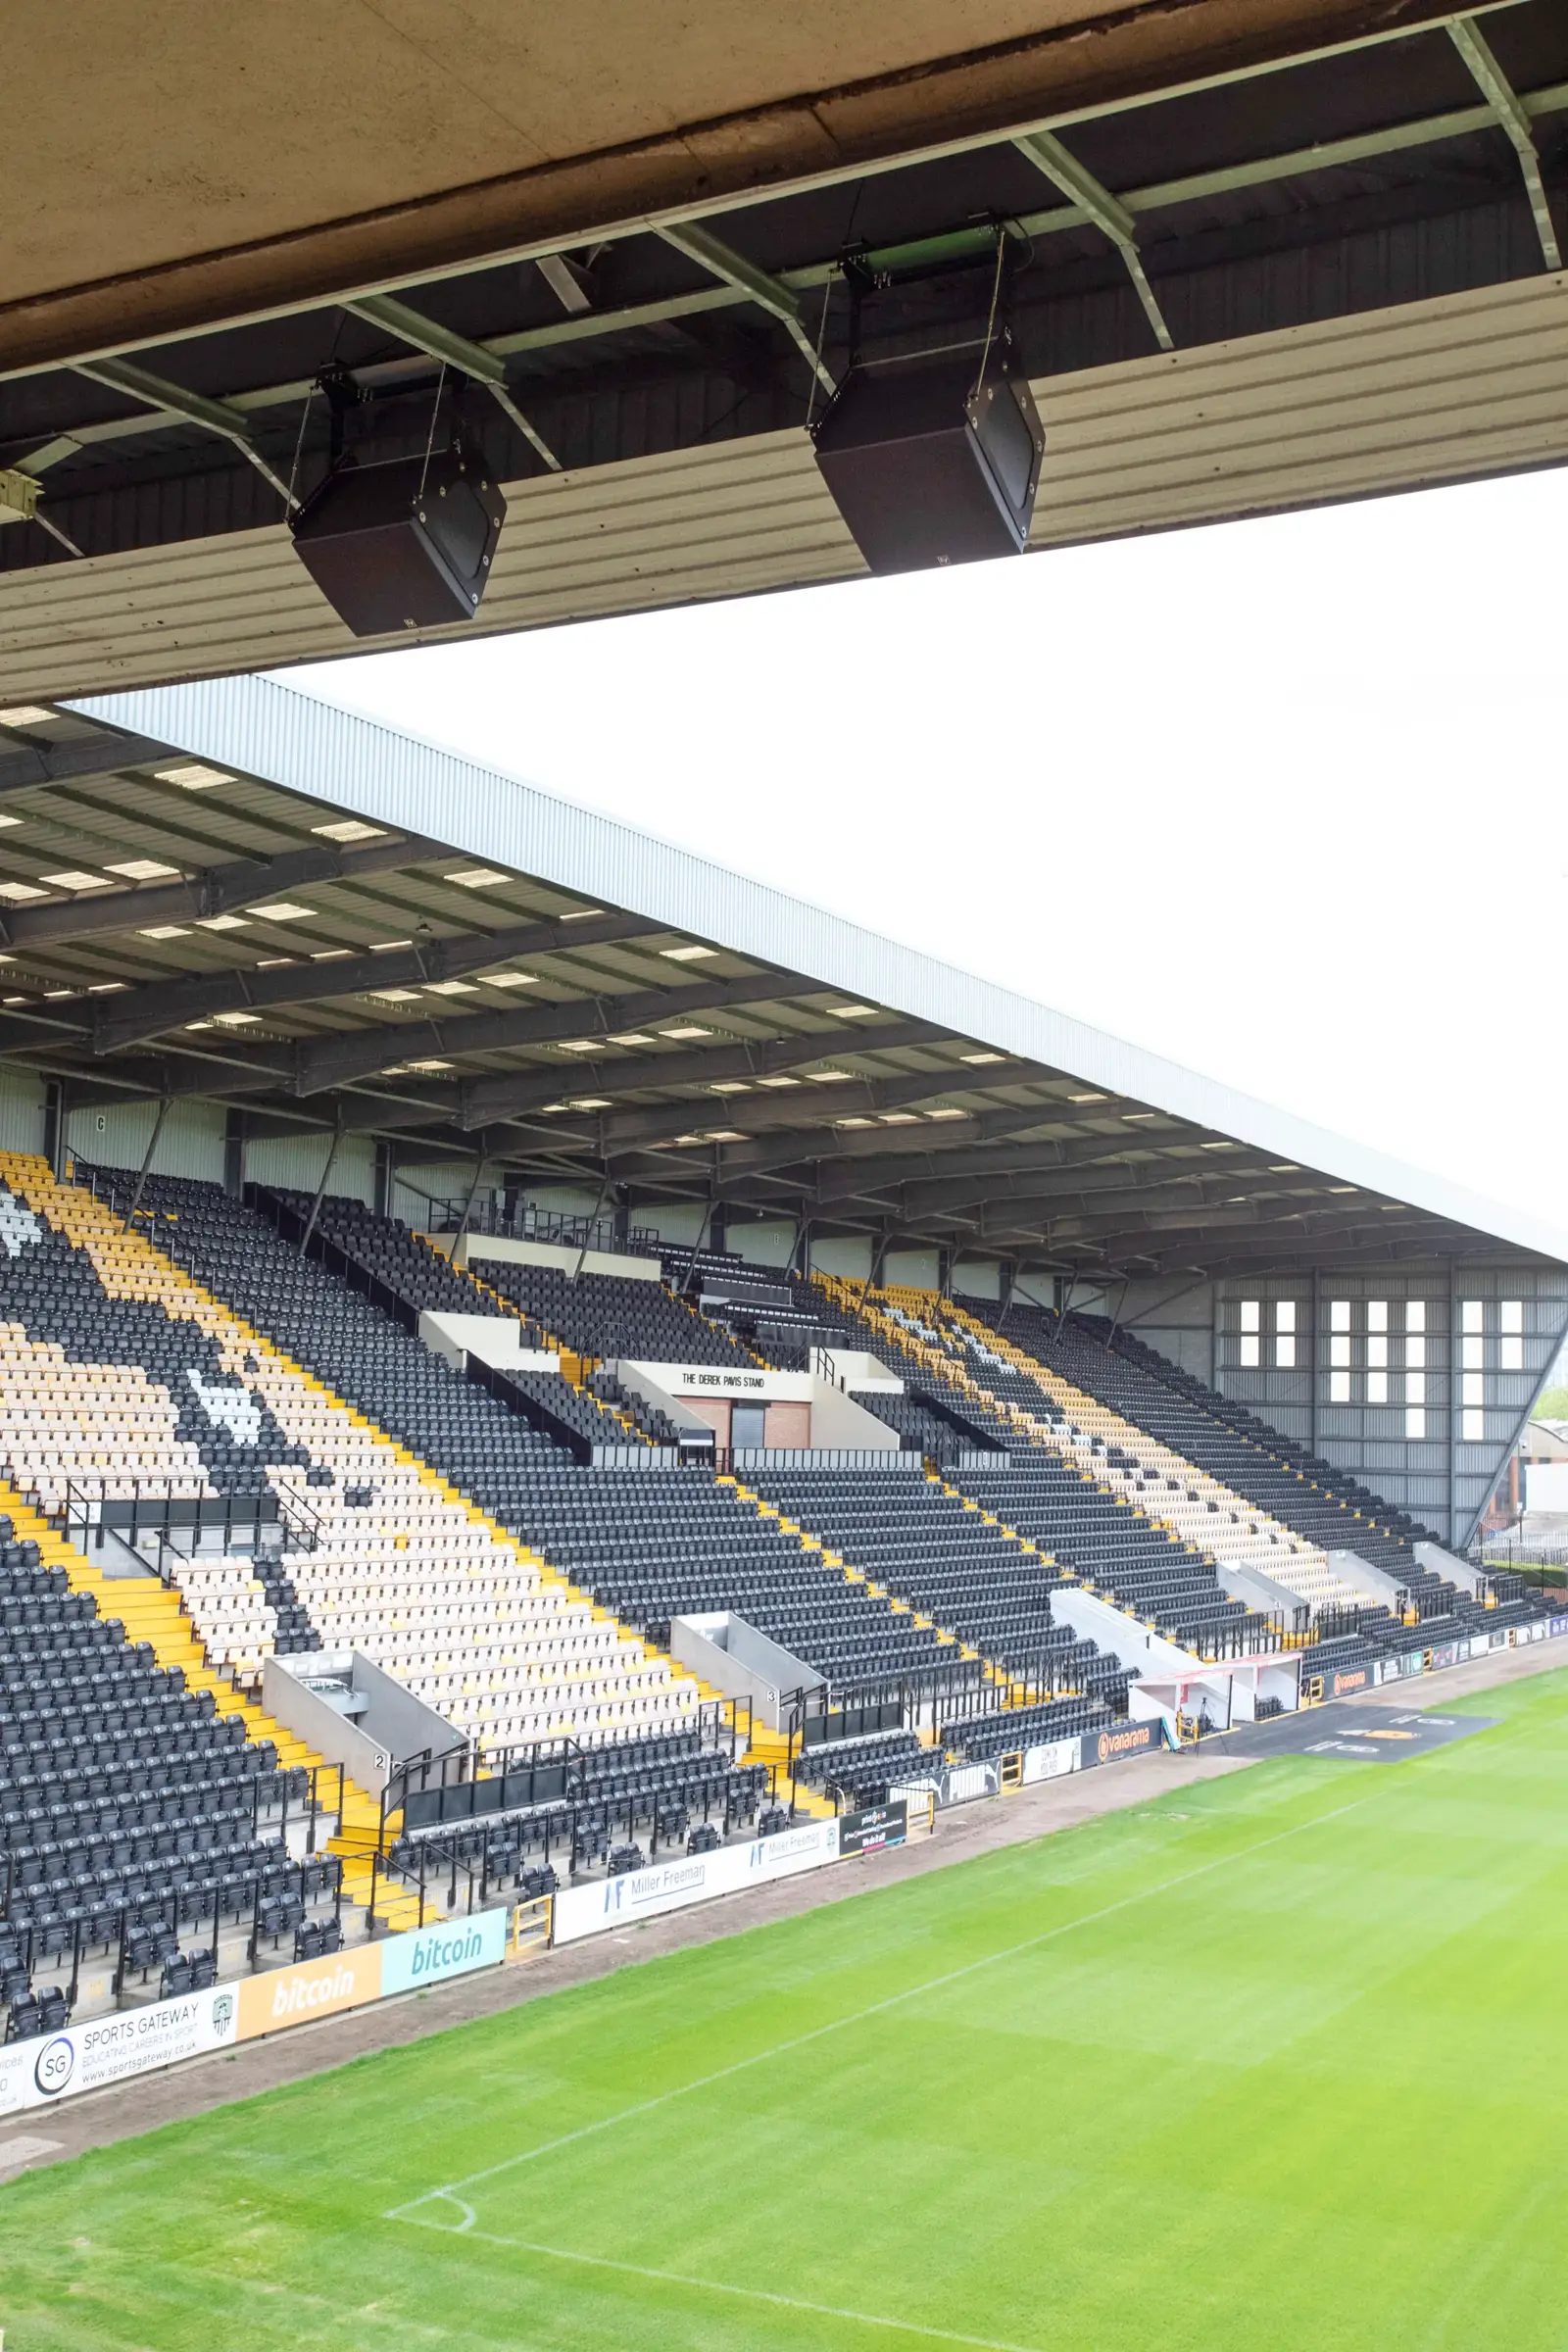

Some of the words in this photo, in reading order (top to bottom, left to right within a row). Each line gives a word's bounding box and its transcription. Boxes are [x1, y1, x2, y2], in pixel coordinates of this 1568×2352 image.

[682, 1373, 696, 1384] THE
[699, 1374, 721, 1386] DEREK
[723, 1376, 742, 1387] PAVIS
[743, 1377, 764, 1388] STAND
[768, 1690, 775, 1701] 3
[1108, 1727, 1150, 1752] vanarama
[376, 1755, 384, 1768] 2
[631, 1875, 661, 1895] Miller
[663, 1864, 706, 1887] Freeman
[412, 1927, 482, 1976] bitcoin
[271, 1964, 355, 2017] bitcoin
[83, 2021, 134, 2050] SPORTS
[137, 2002, 199, 2034] GATEWAY
[82, 2046, 128, 2068] EDUCATING
[128, 2034, 165, 2052] CAREERS
[45, 2055, 66, 2077] SG
